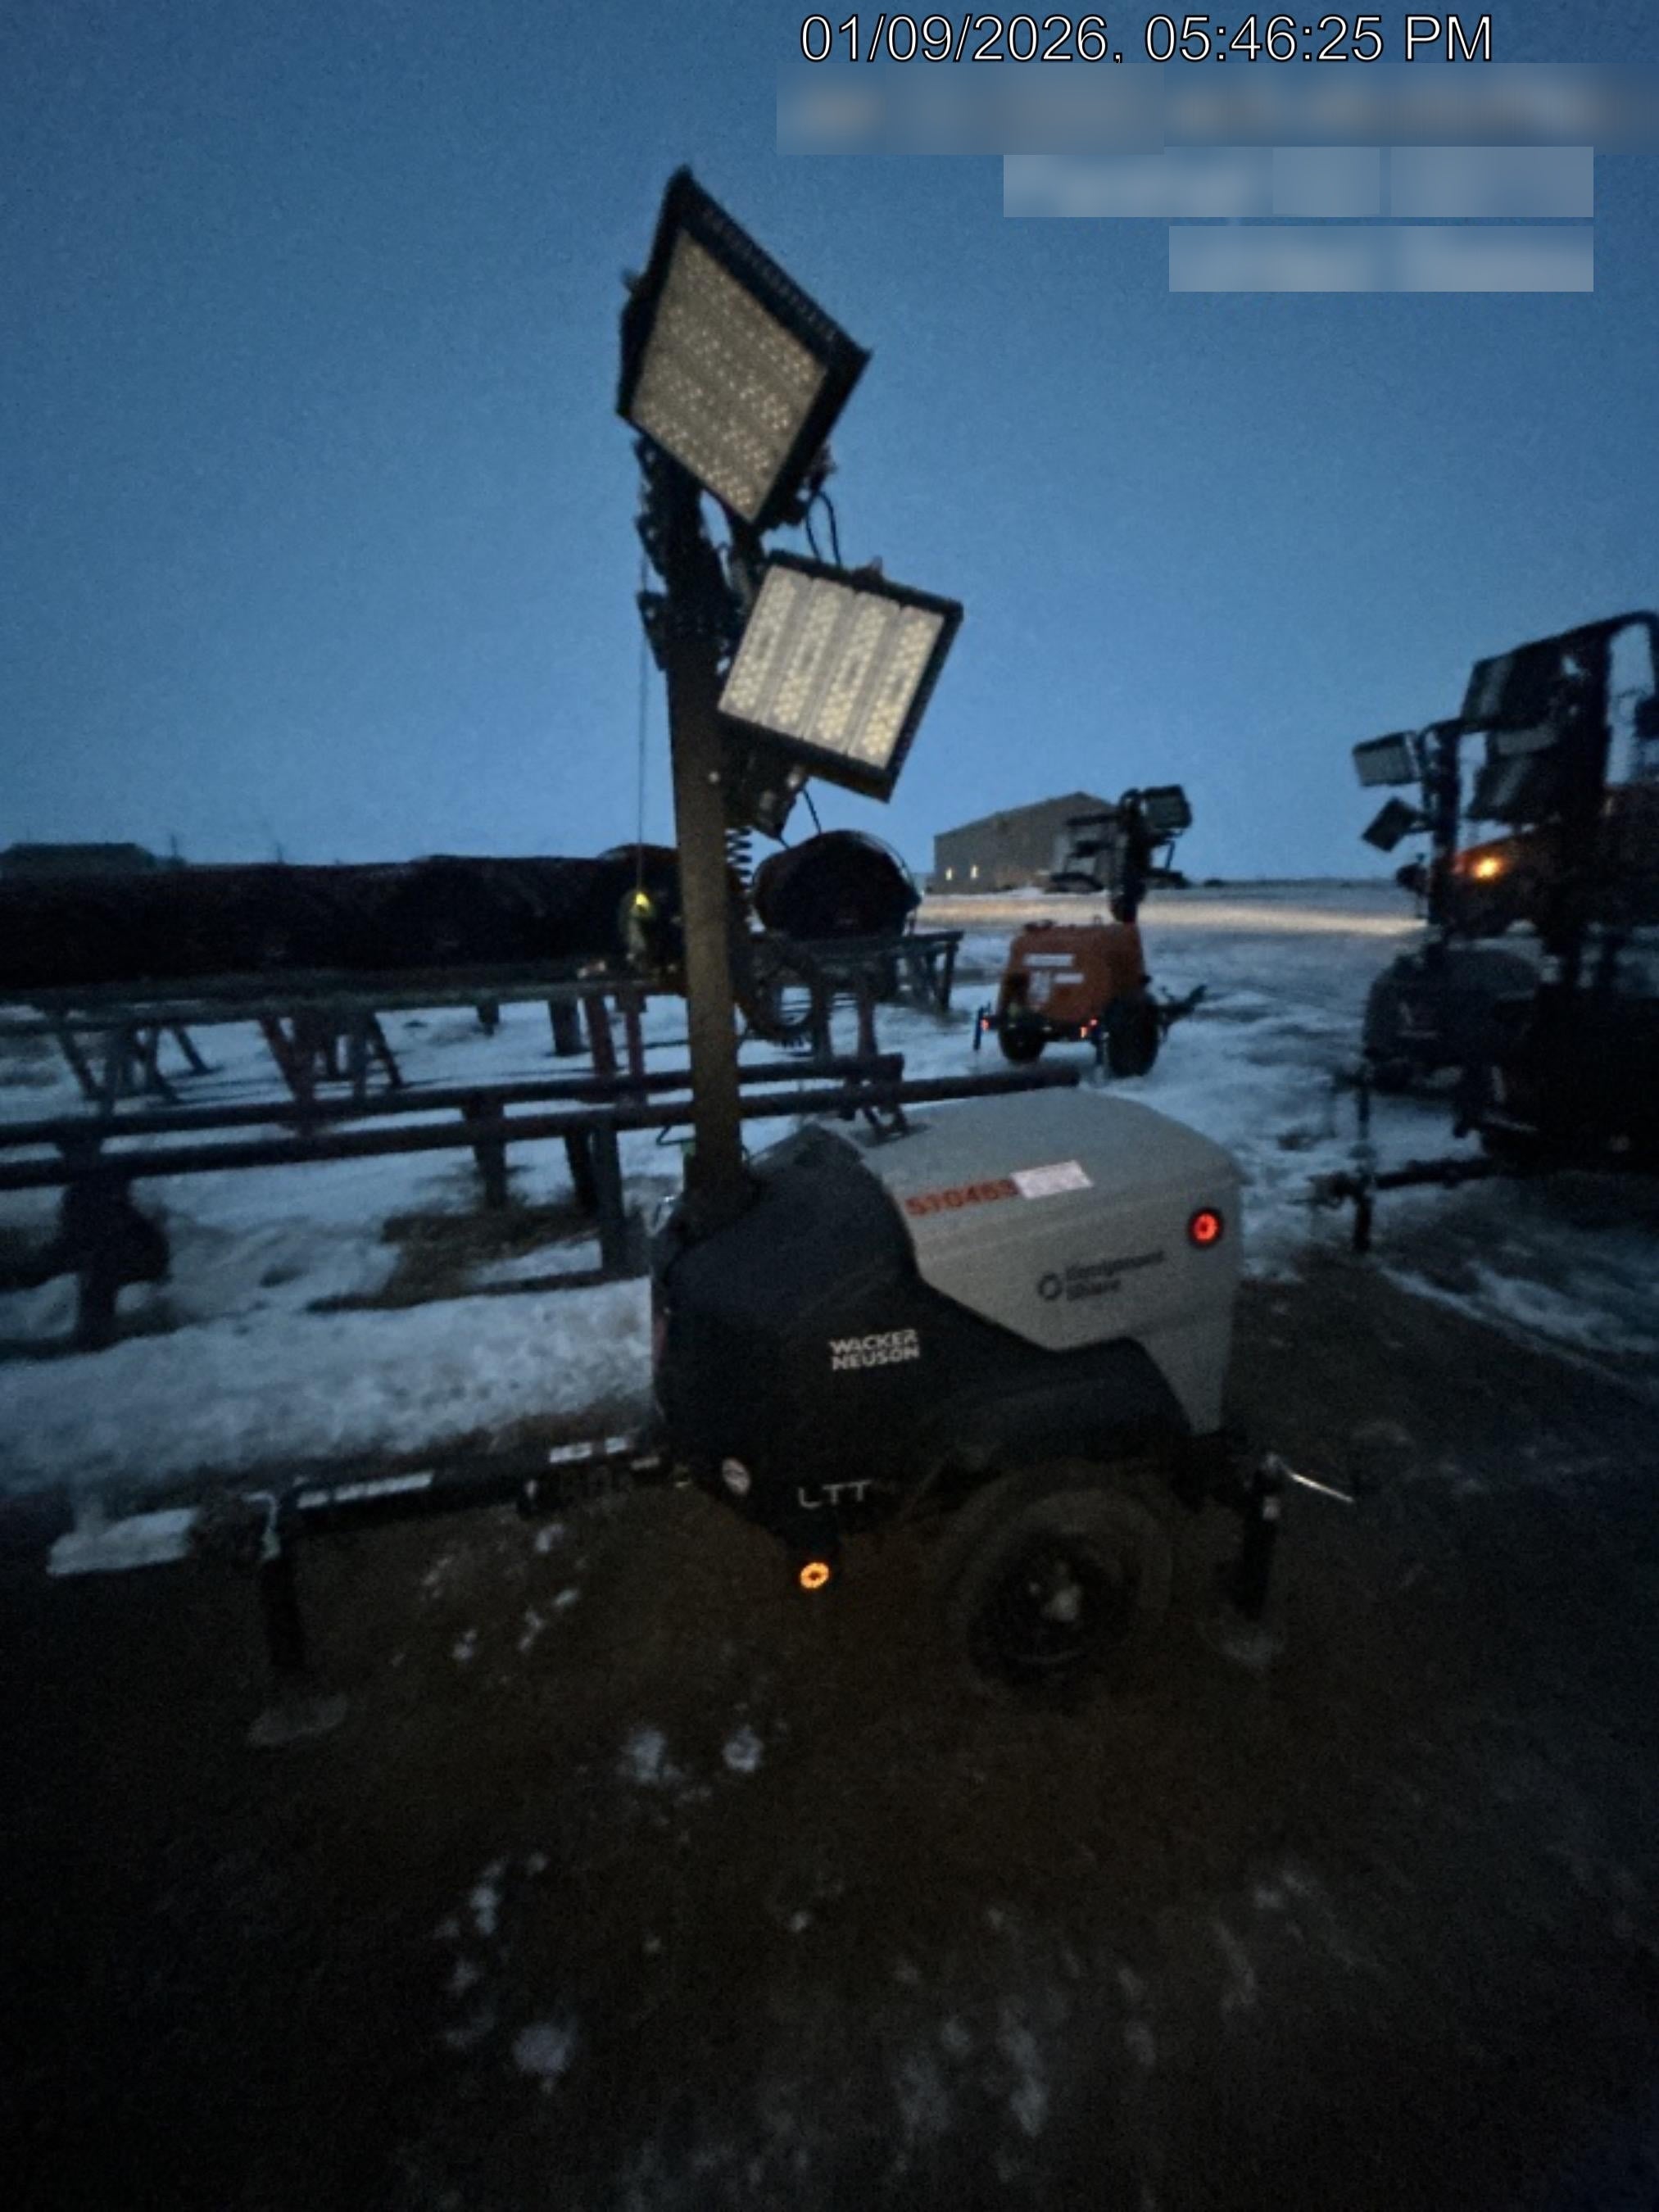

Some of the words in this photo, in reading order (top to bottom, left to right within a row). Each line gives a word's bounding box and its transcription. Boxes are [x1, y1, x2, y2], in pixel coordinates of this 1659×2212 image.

[829, 1329, 917, 1354] WACKER
[832, 1346, 919, 1370] NEUSON
[797, 1479, 873, 1509] LTT
